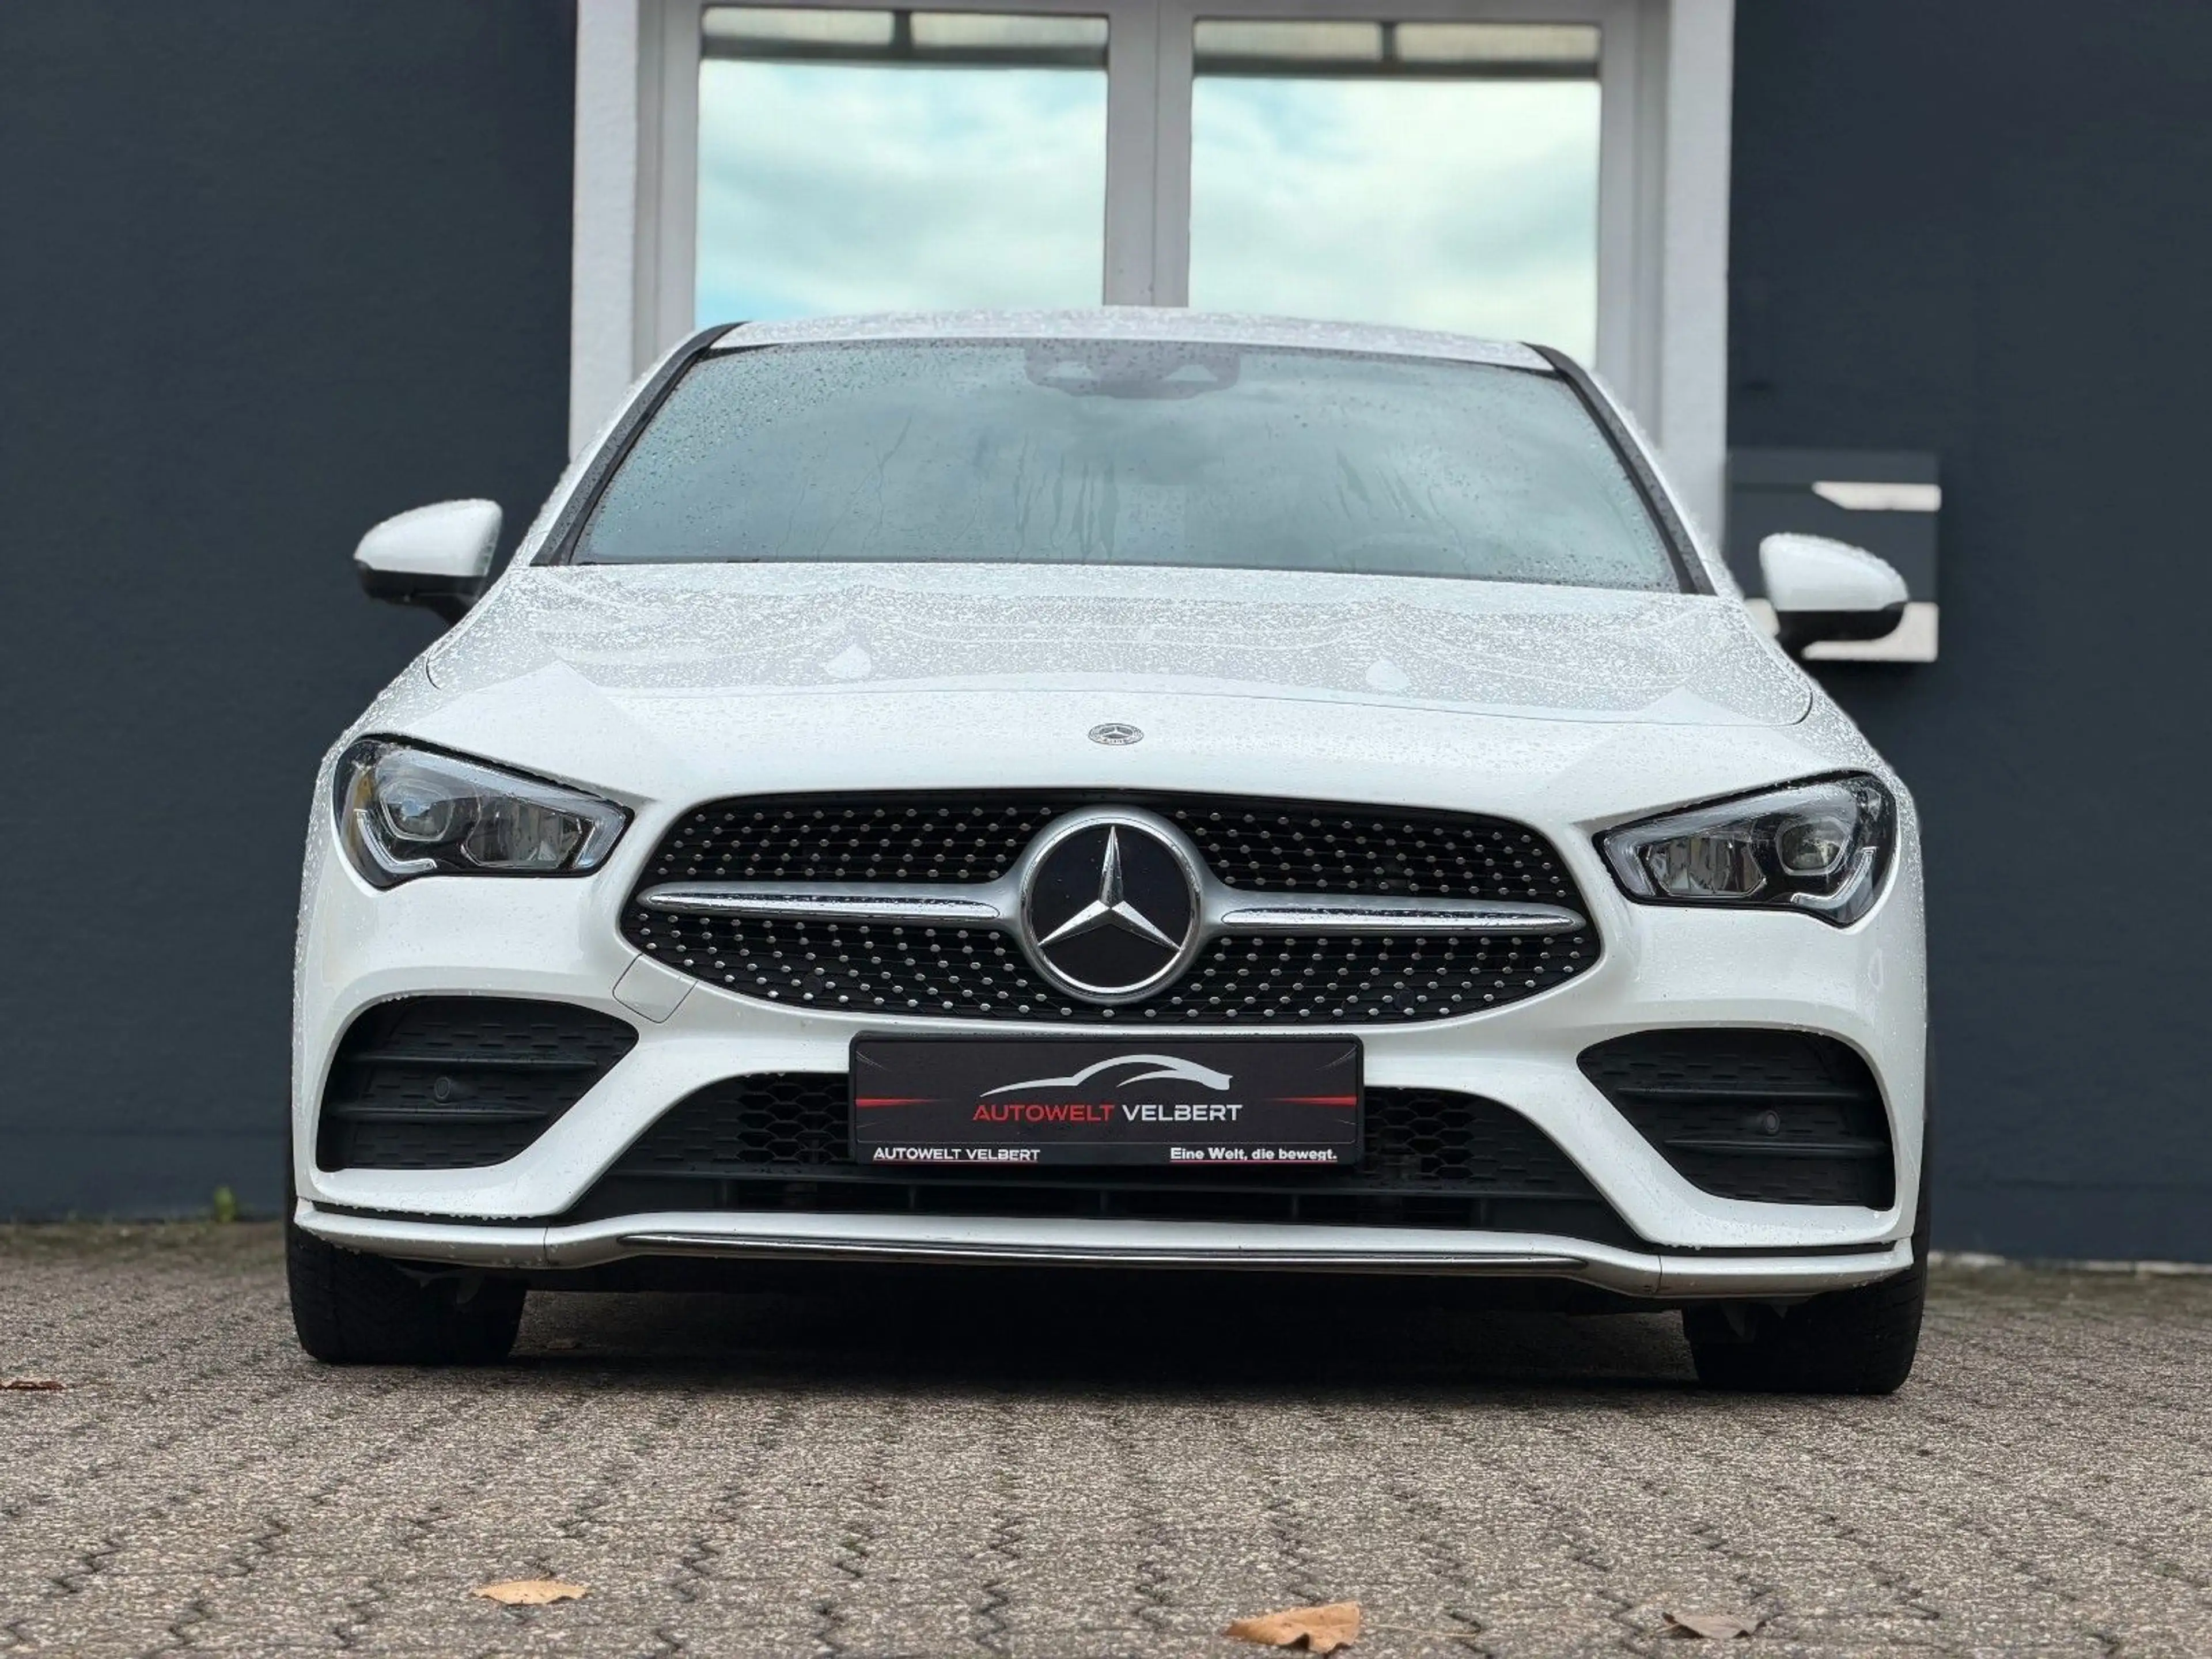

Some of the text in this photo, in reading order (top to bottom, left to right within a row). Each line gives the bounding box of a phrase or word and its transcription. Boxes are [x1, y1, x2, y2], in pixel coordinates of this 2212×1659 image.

[972, 1104, 1243, 1122] AUTOWELT VELBERT
[873, 1147, 1041, 1161] AUTOWELT VELBERT
[1170, 1147, 1338, 1161] Eine Welt, die bewegt.
